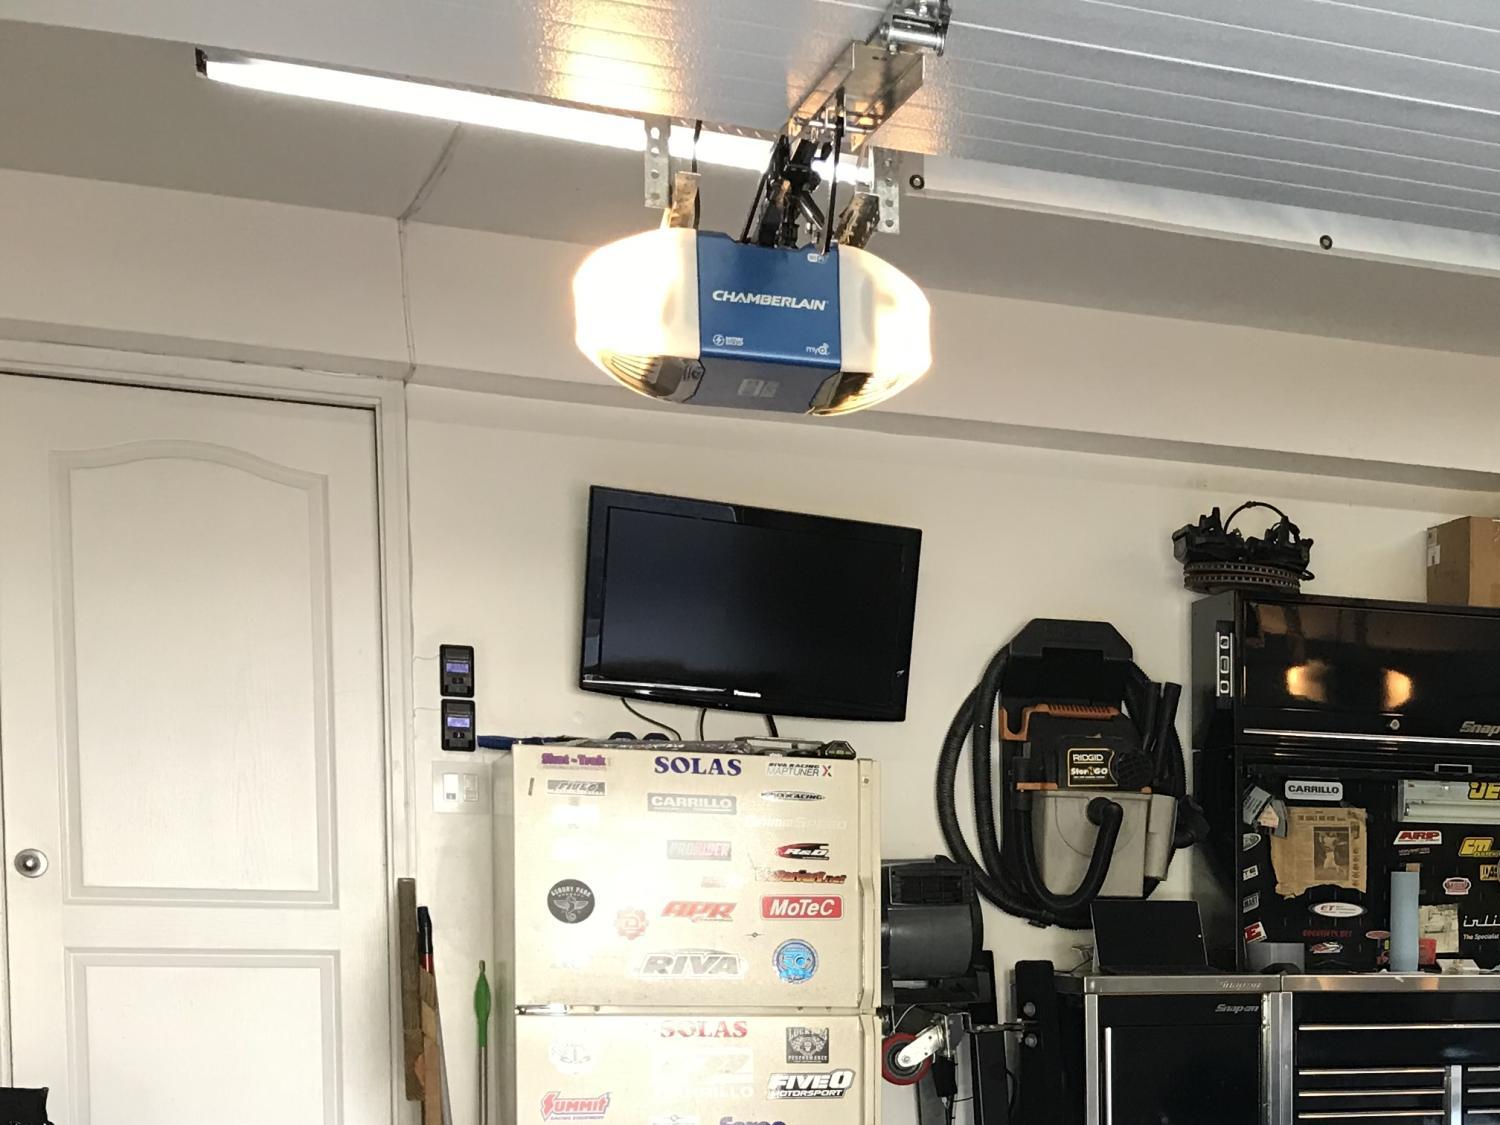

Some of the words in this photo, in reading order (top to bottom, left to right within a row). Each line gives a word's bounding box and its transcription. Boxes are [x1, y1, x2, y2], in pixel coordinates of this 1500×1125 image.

[712, 290, 826, 311] CHAMBERLAIN
[1072, 754, 1104, 762] RIDGID
[654, 756, 742, 777] SOLAS
[767, 767, 819, 777] MAPTUNER
[1288, 785, 1340, 794] CARRILLO
[652, 796, 732, 809] CARRILLO
[1398, 832, 1440, 841] ARP
[661, 901, 737, 918] APR
[770, 899, 835, 916] MoTeC
[643, 956, 738, 974] RIVA
[1215, 1003, 1259, 1013] Snap-on
[660, 1021, 748, 1038] SOLAS
[769, 1089, 843, 1097] MOTORSPORT
[543, 1093, 607, 1117] SUMMIT
